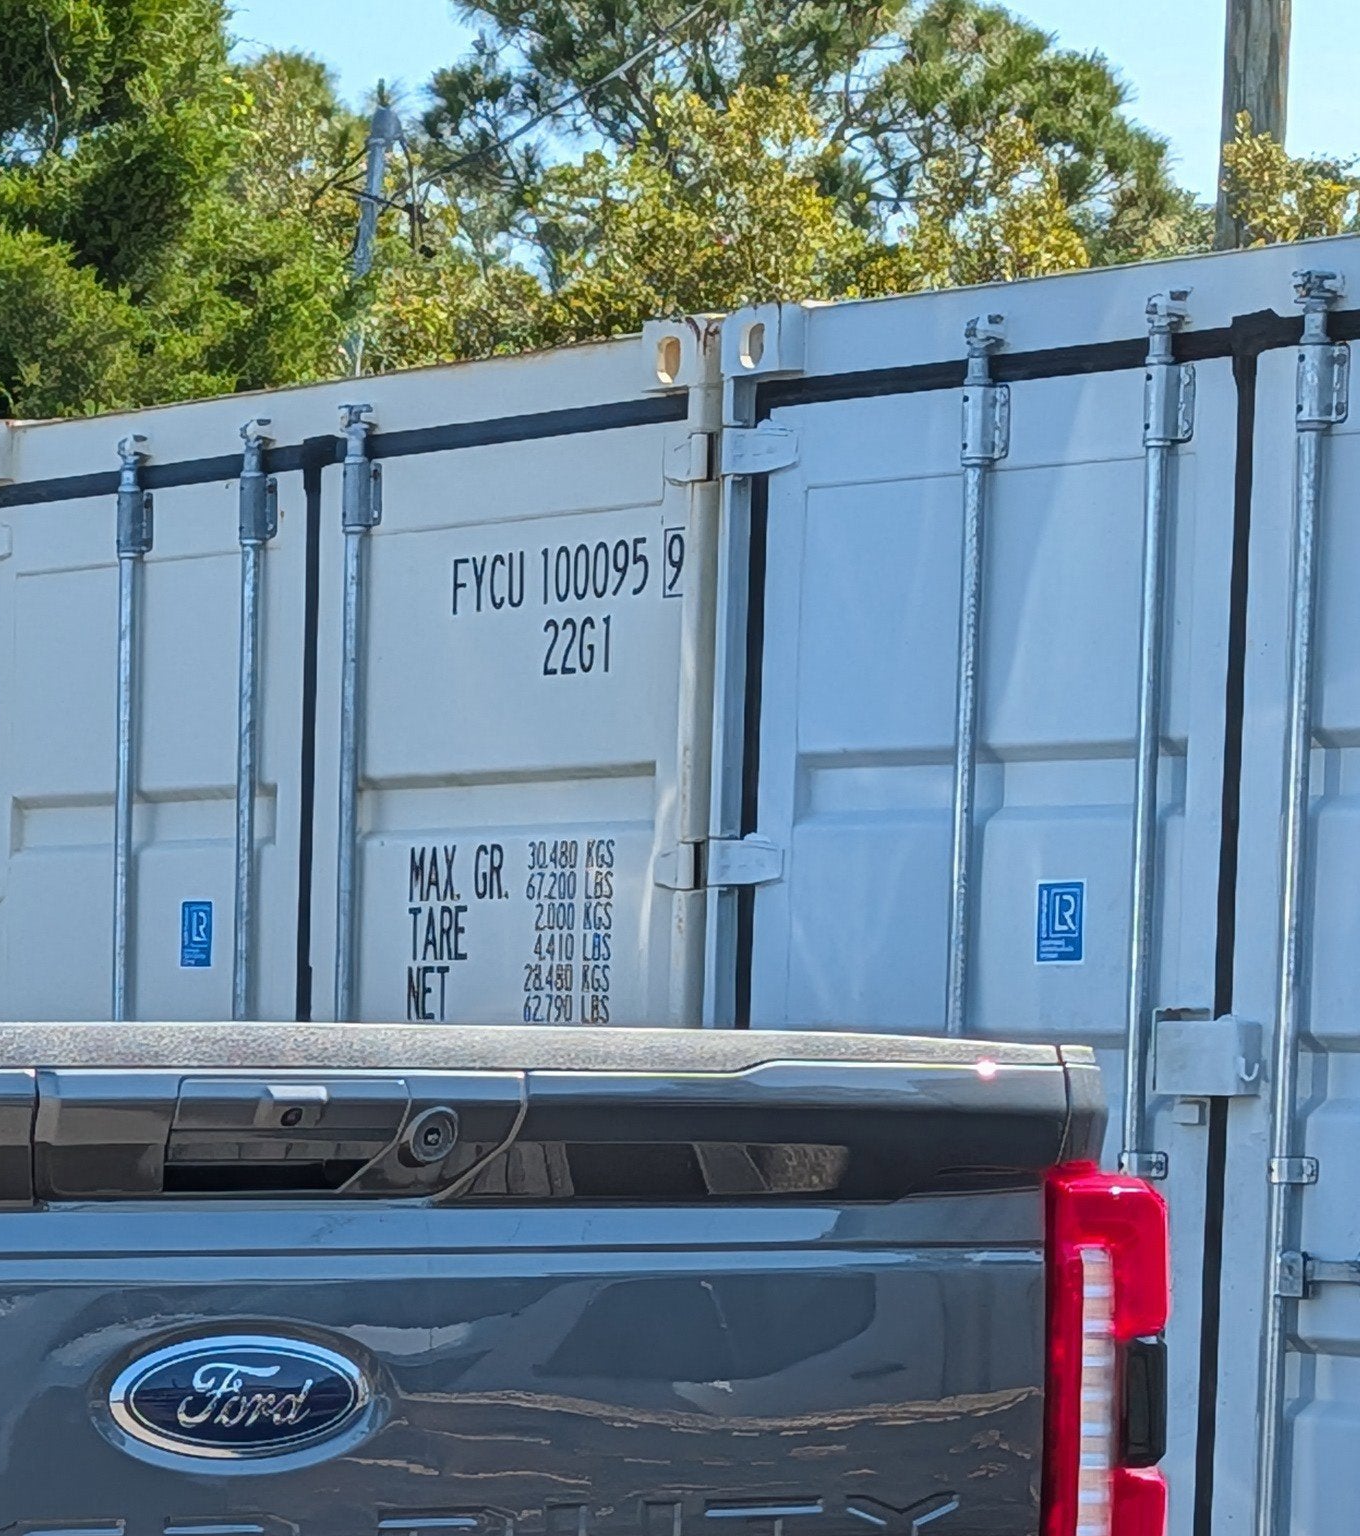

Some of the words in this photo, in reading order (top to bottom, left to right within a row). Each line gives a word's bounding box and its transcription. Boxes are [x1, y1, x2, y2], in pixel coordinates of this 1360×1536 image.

[452, 550, 525, 616] FYCU
[541, 536, 650, 605] 100095
[667, 532, 686, 592] 9
[542, 614, 612, 676] 22G1
[408, 844, 462, 903] MAX.
[473, 843, 510, 900] GR.
[585, 838, 616, 869] KGS
[584, 870, 614, 900] LBS
[407, 904, 469, 962] TARE
[582, 901, 614, 931] KGS
[582, 932, 612, 962] LBS
[406, 965, 450, 1022] NET
[580, 963, 611, 994] KGS
[580, 994, 610, 1024] LBS
[175, 1360, 315, 1429] Ford
